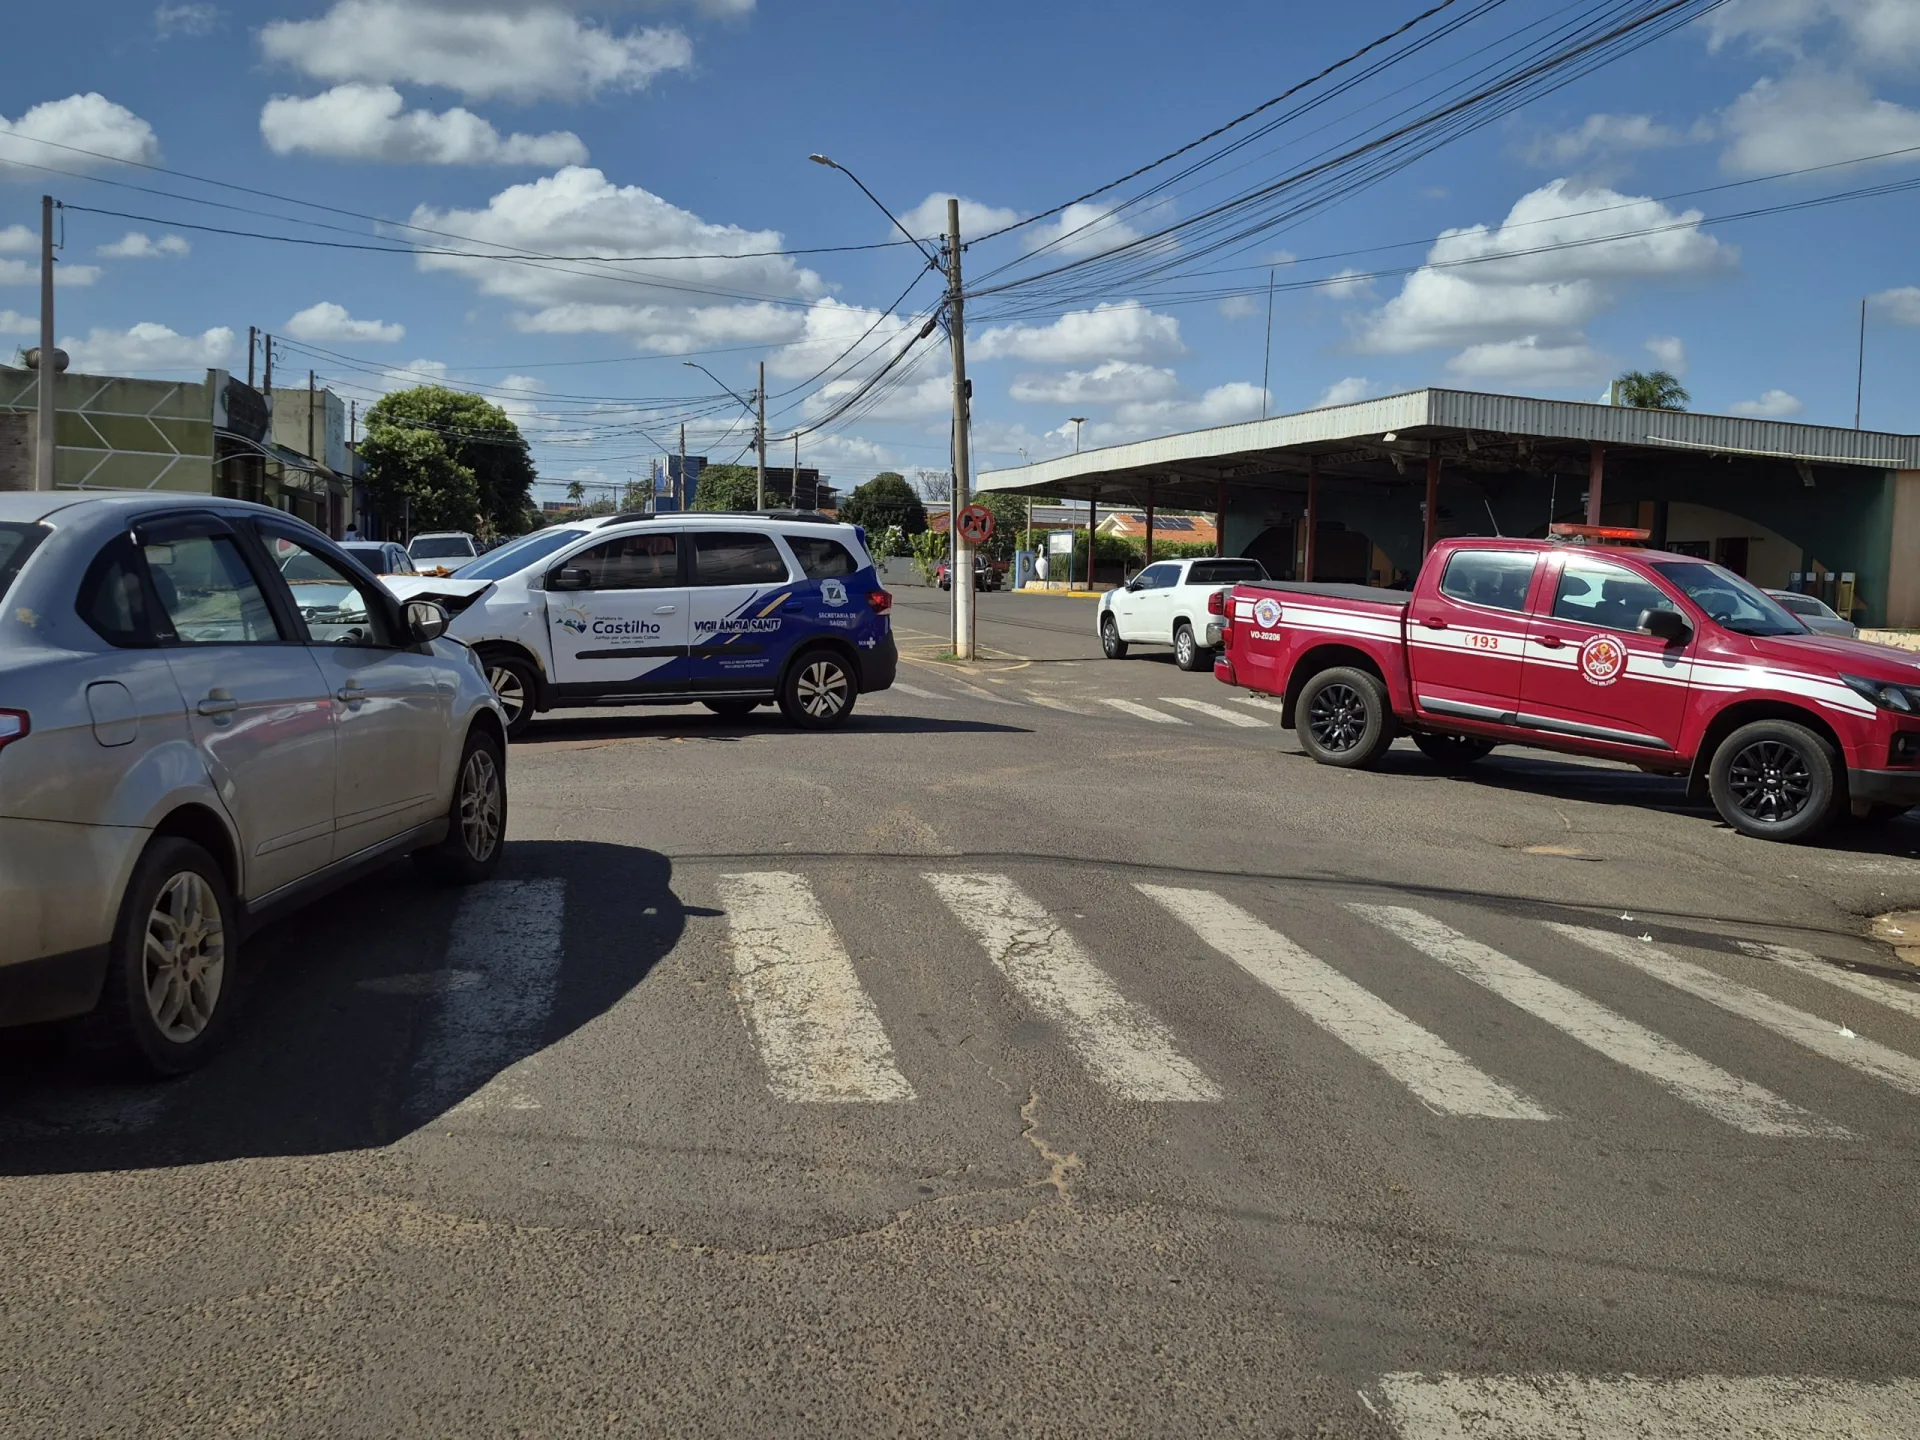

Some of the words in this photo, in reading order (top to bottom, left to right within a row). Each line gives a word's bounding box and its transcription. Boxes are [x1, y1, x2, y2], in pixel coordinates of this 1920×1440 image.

[592, 620, 661, 634] Castilho
[1250, 630, 1281, 641] VO-20206
[1471, 635, 1498, 649] 193
[1581, 634, 1599, 648] CORPO
